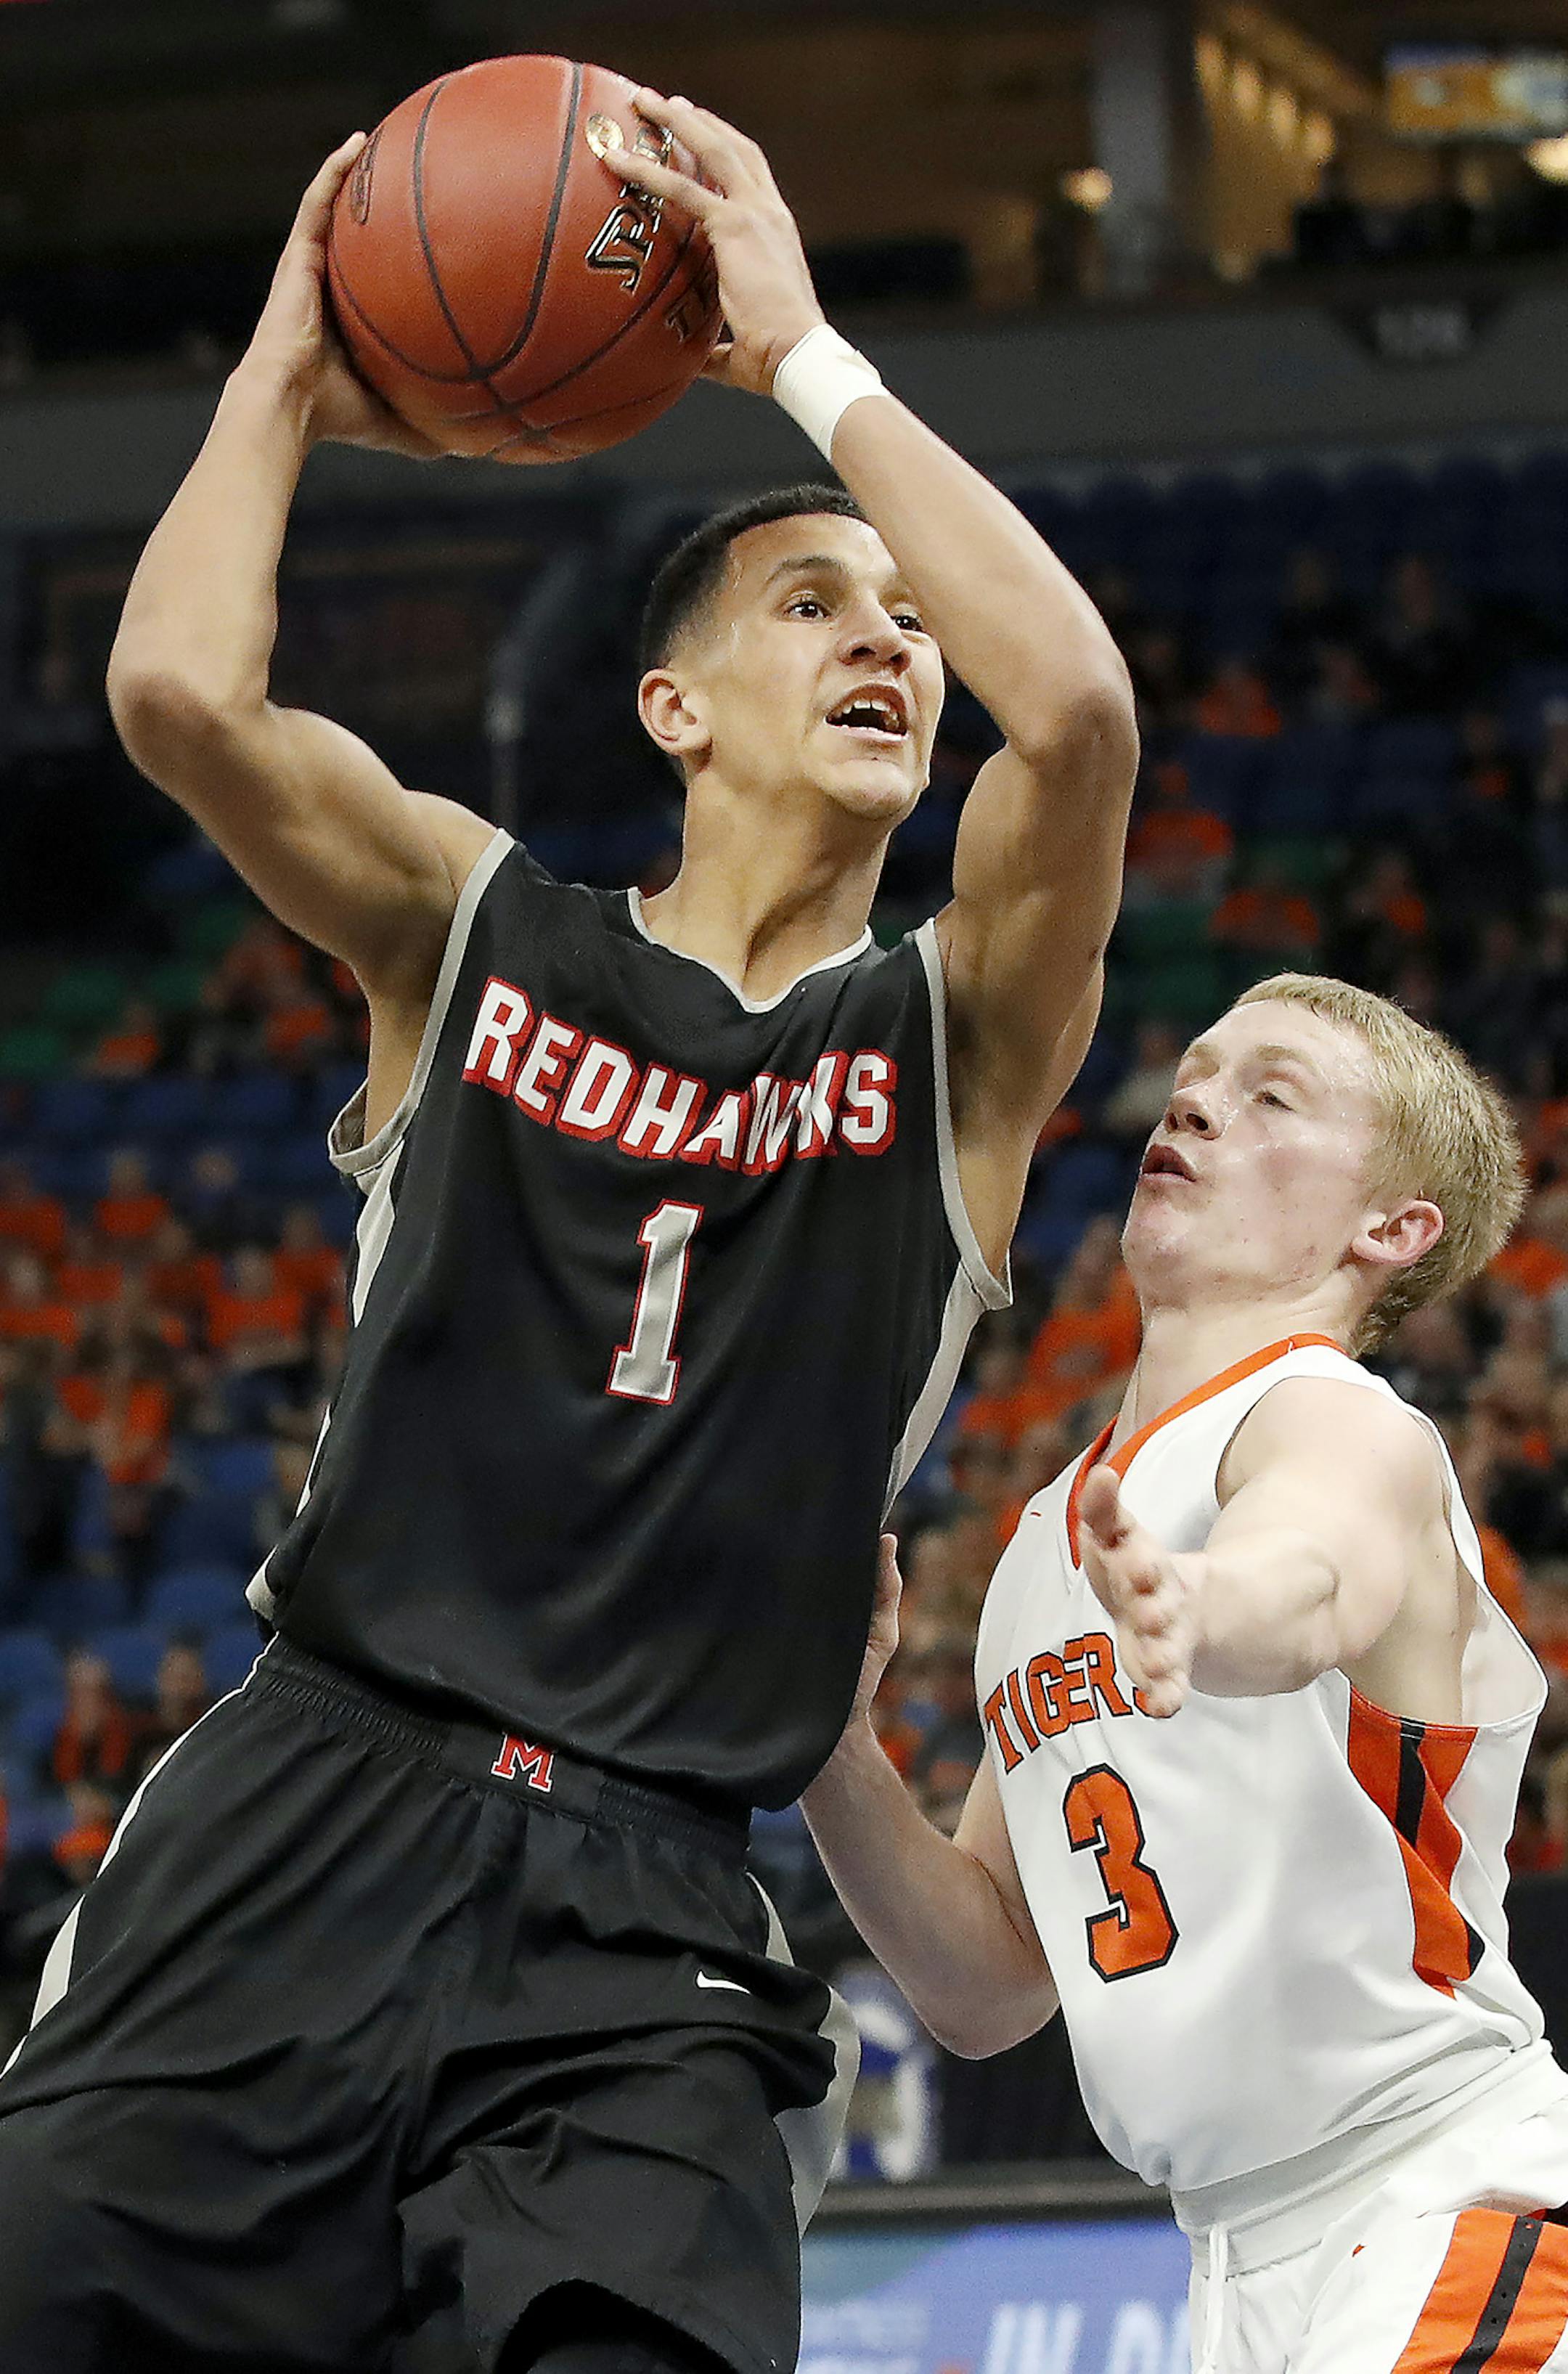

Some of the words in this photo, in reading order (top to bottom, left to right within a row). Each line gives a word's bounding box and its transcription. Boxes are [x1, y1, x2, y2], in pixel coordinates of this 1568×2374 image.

[462, 976, 897, 1176] REDHAWKS
[605, 1198, 704, 1406] 1
[491, 1733, 555, 1793] M
[1062, 1762, 1180, 1984] 3
